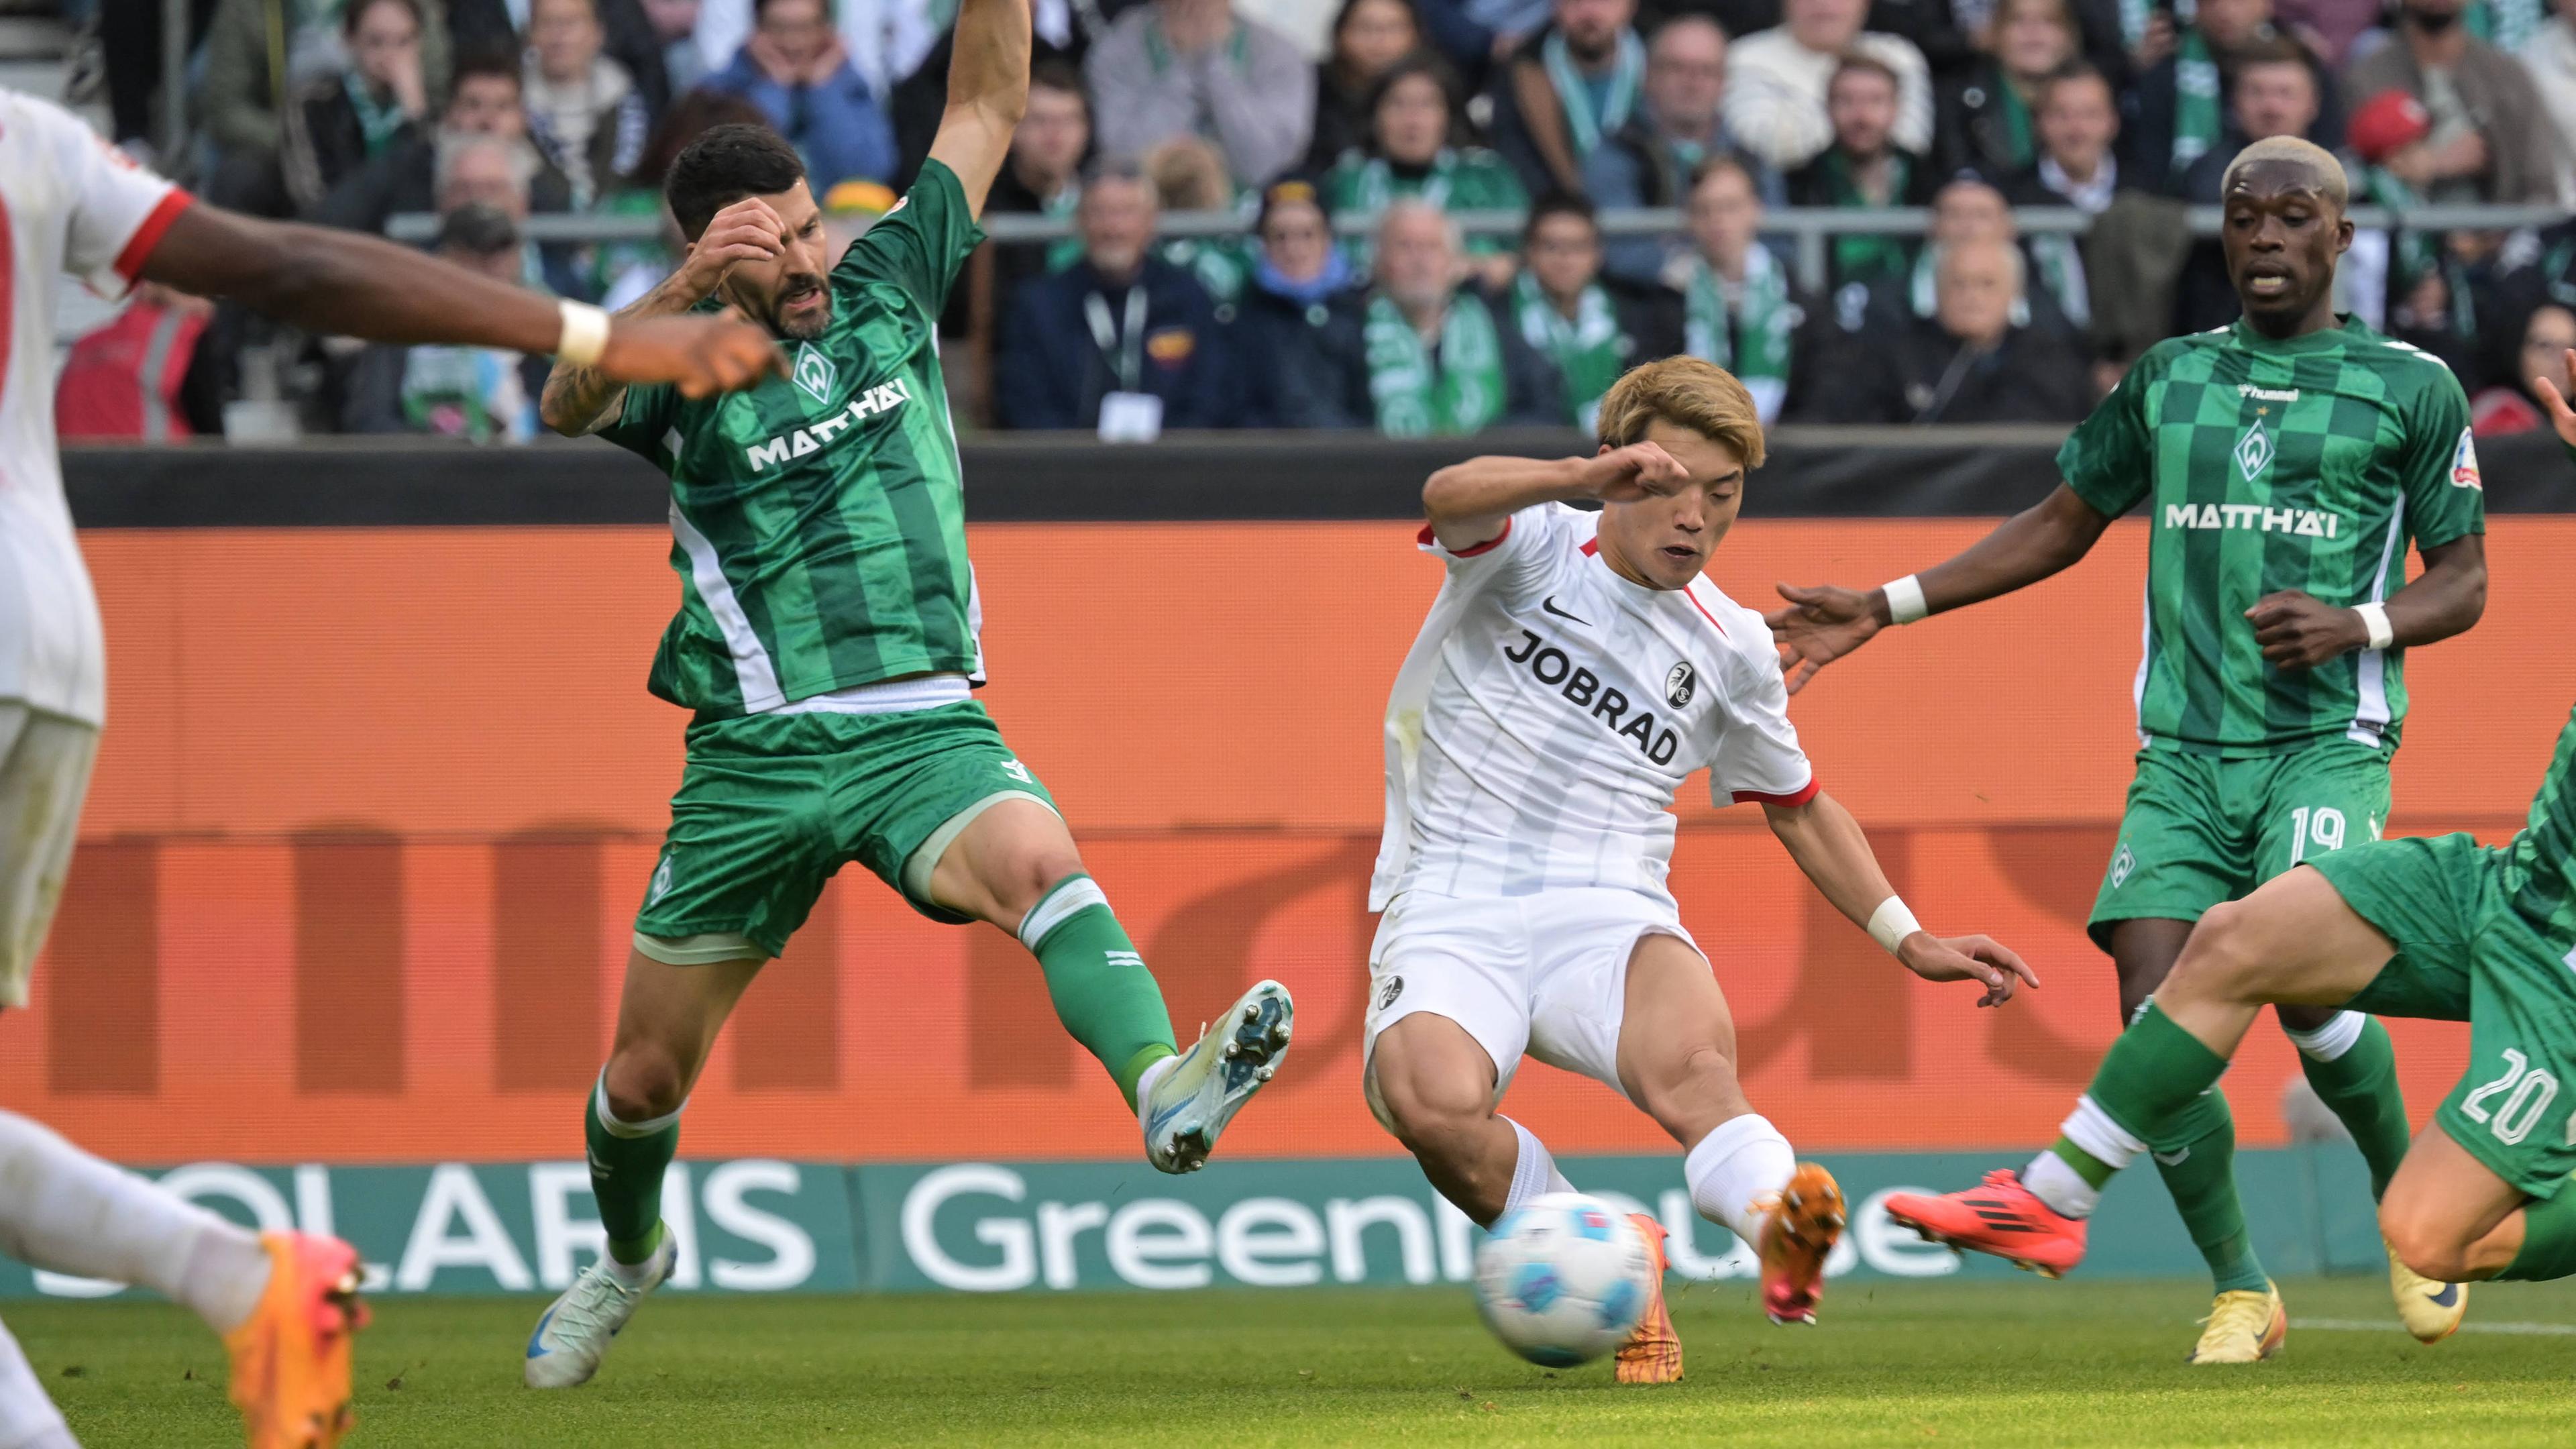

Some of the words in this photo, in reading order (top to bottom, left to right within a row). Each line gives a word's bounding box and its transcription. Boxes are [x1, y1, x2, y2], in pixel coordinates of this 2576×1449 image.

[746, 378, 912, 472] MATTHÄI
[2165, 503, 2338, 539] MATTHÄI
[1503, 628, 1678, 766] JOBRAD
[2290, 806, 2346, 869] 19
[2459, 1046, 2559, 1146] 20
[32, 1159, 816, 1298] LARIS
[900, 1161, 1962, 1293] Greenue
